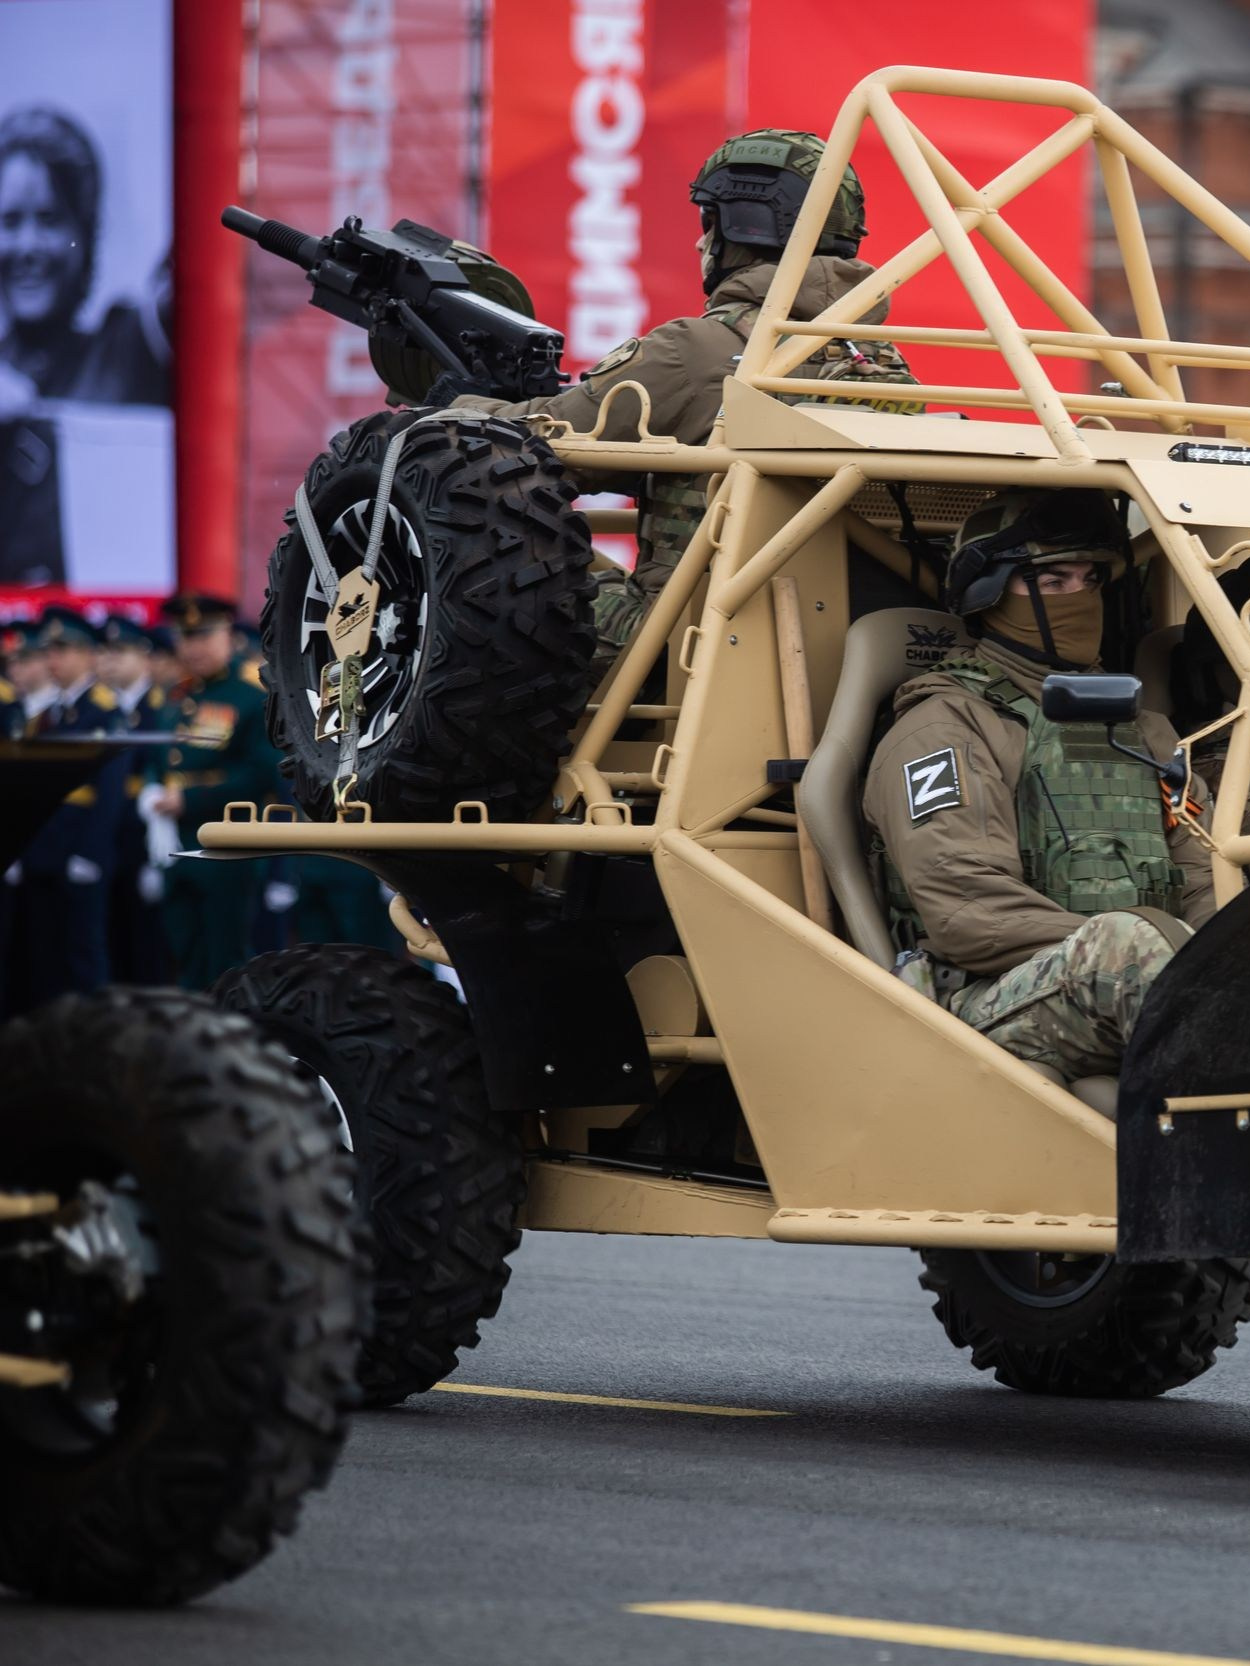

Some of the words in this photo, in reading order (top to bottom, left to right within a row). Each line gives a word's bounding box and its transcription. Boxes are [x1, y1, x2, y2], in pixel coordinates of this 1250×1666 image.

[735, 145, 783, 159] ПСИХ
[906, 649, 948, 661] CHAB
[911, 760, 955, 806] Z
